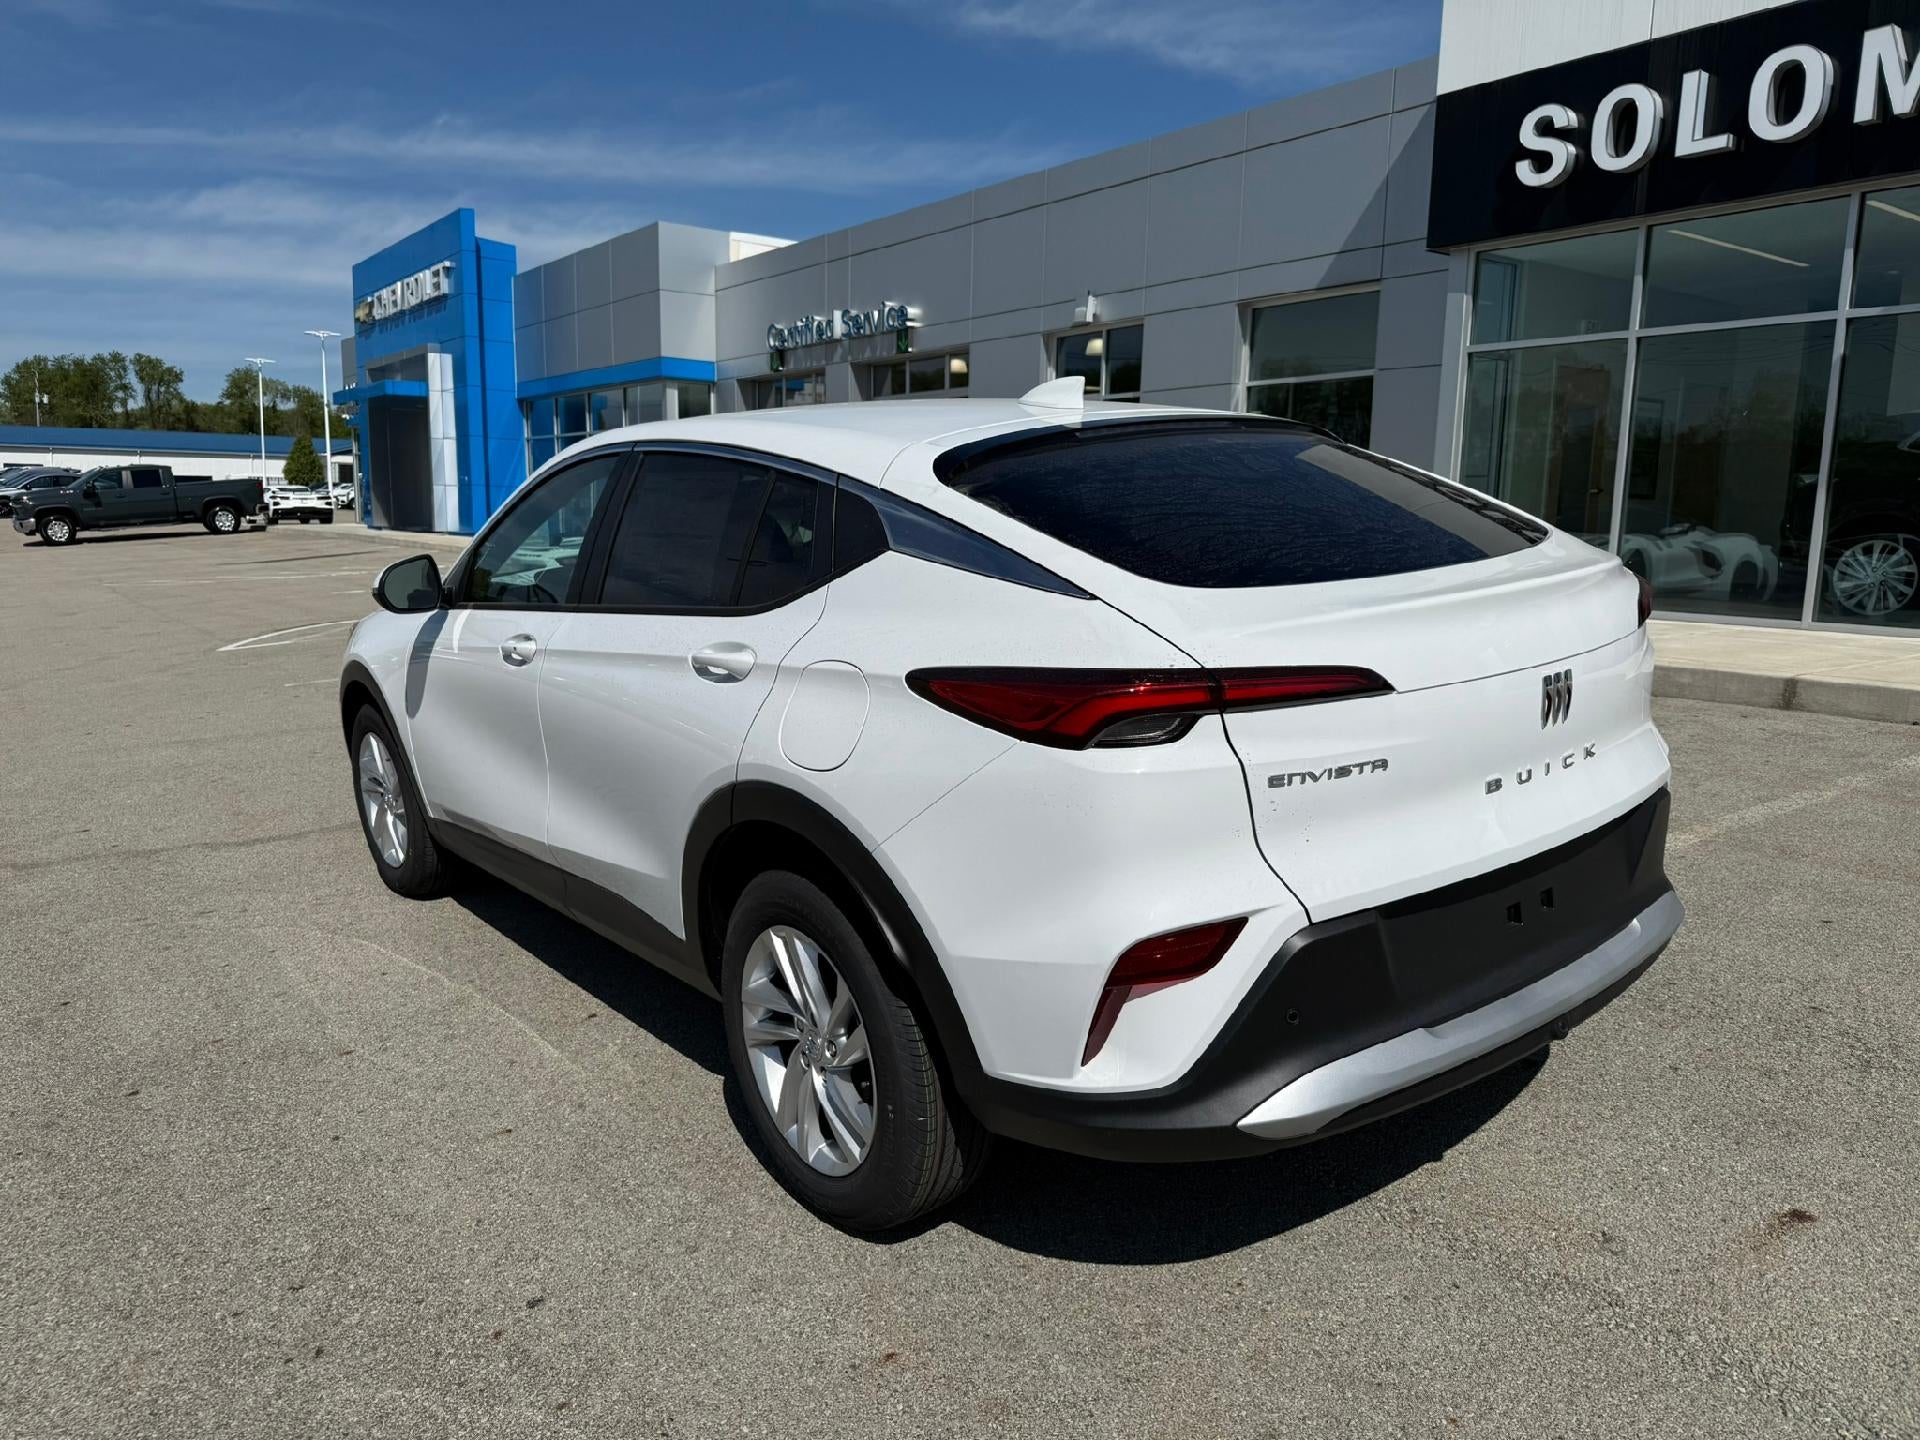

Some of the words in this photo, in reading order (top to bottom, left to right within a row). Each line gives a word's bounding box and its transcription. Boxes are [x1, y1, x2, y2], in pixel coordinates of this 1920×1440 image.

[767, 317, 834, 350] Certified
[840, 302, 909, 338] Service
[1267, 757, 1390, 789] ENVISTA
[1485, 742, 1597, 795] BUICK
